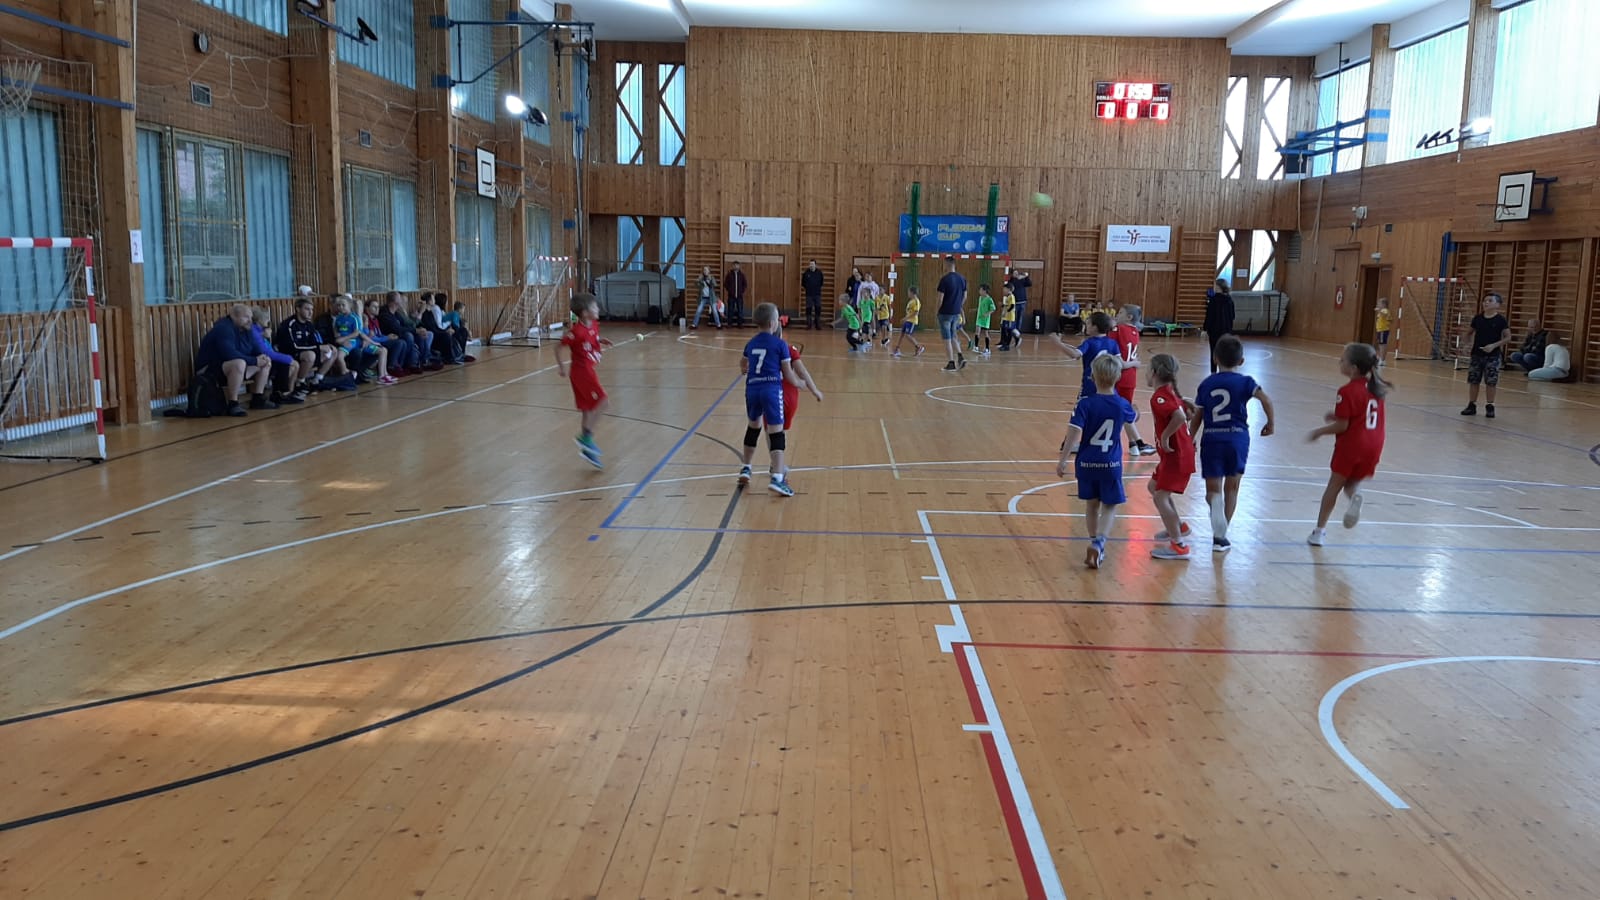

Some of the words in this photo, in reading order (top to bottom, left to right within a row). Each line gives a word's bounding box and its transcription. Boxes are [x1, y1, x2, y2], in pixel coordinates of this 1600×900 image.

[751, 348, 767, 374] 7
[1210, 388, 1231, 422] 2
[1366, 398, 1378, 430] 6
[1090, 419, 1114, 453] 4
